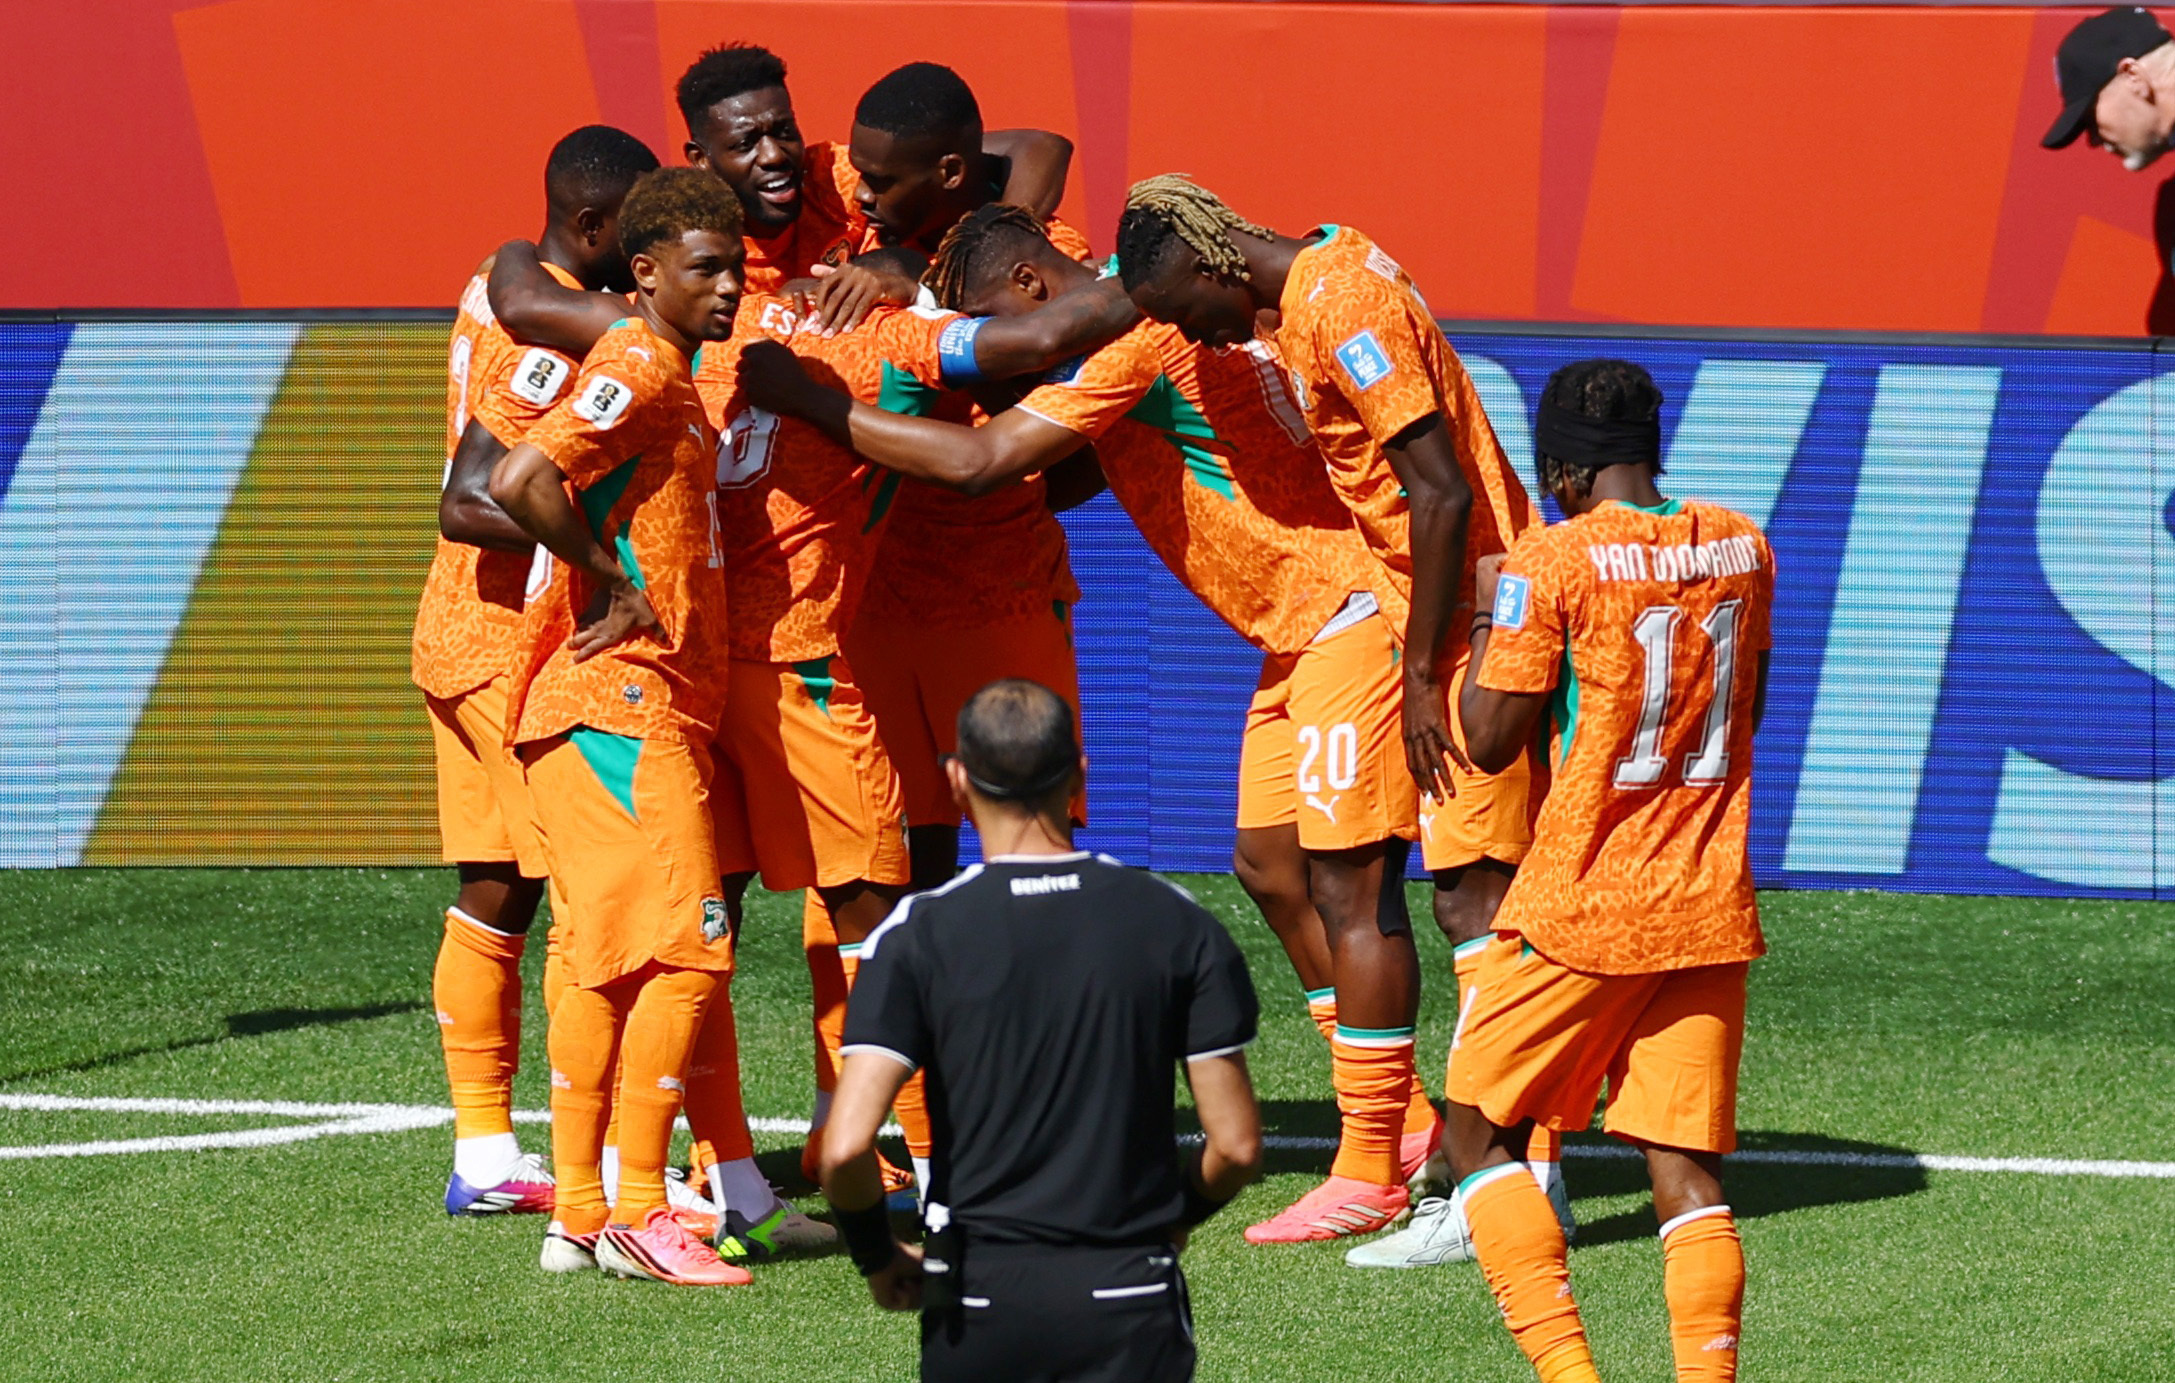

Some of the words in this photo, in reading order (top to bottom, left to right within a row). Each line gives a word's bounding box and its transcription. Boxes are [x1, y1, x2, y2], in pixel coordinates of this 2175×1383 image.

[1589, 543, 1646, 581] YAN
[1612, 598, 1744, 790] 11
[1298, 722, 1357, 793] 20
